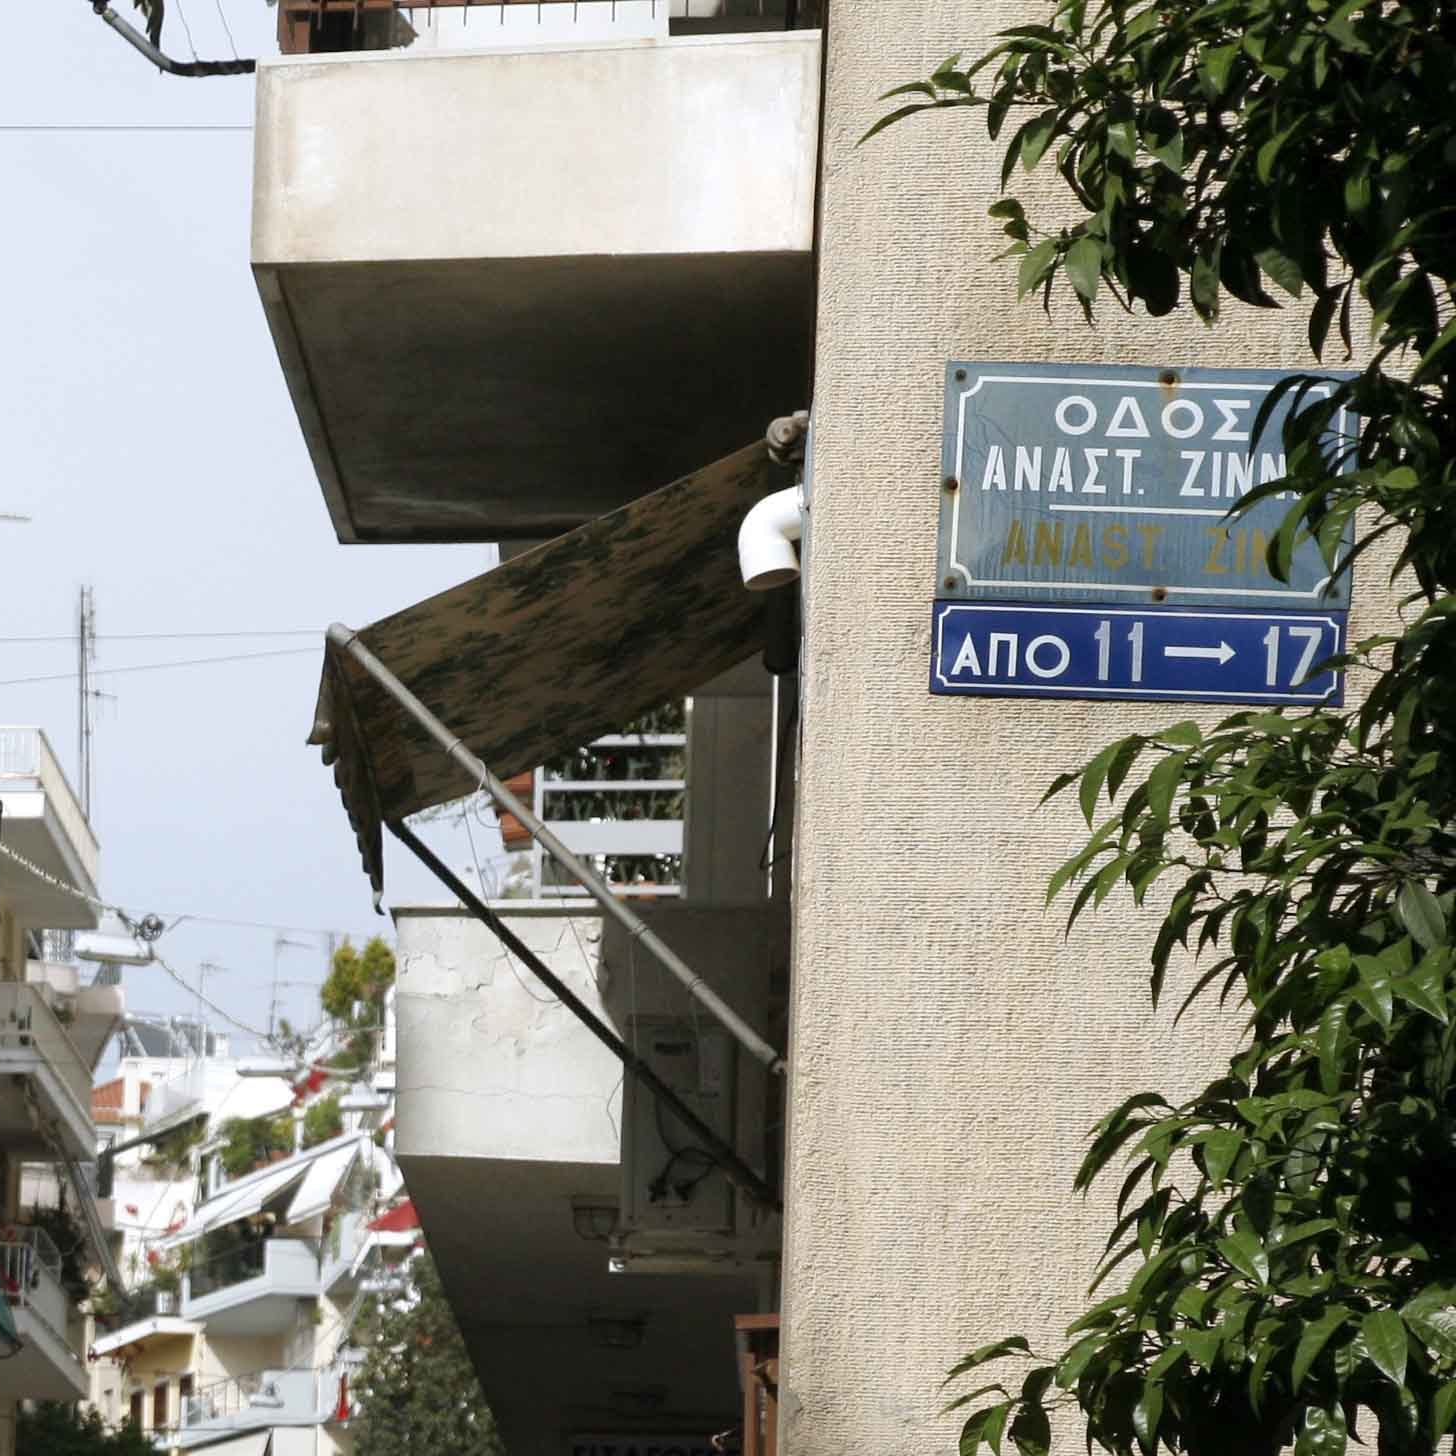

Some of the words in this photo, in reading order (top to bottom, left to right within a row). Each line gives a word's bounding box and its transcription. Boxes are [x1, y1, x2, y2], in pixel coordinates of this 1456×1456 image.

[1054, 394, 1252, 442] ΟΔΟΣ
[981, 444, 1146, 496] ΑΝΑΣΤ.
[950, 632, 1071, 679] ΑΠΟ
[1094, 619, 1144, 683] 11
[1263, 625, 1324, 687] 17
